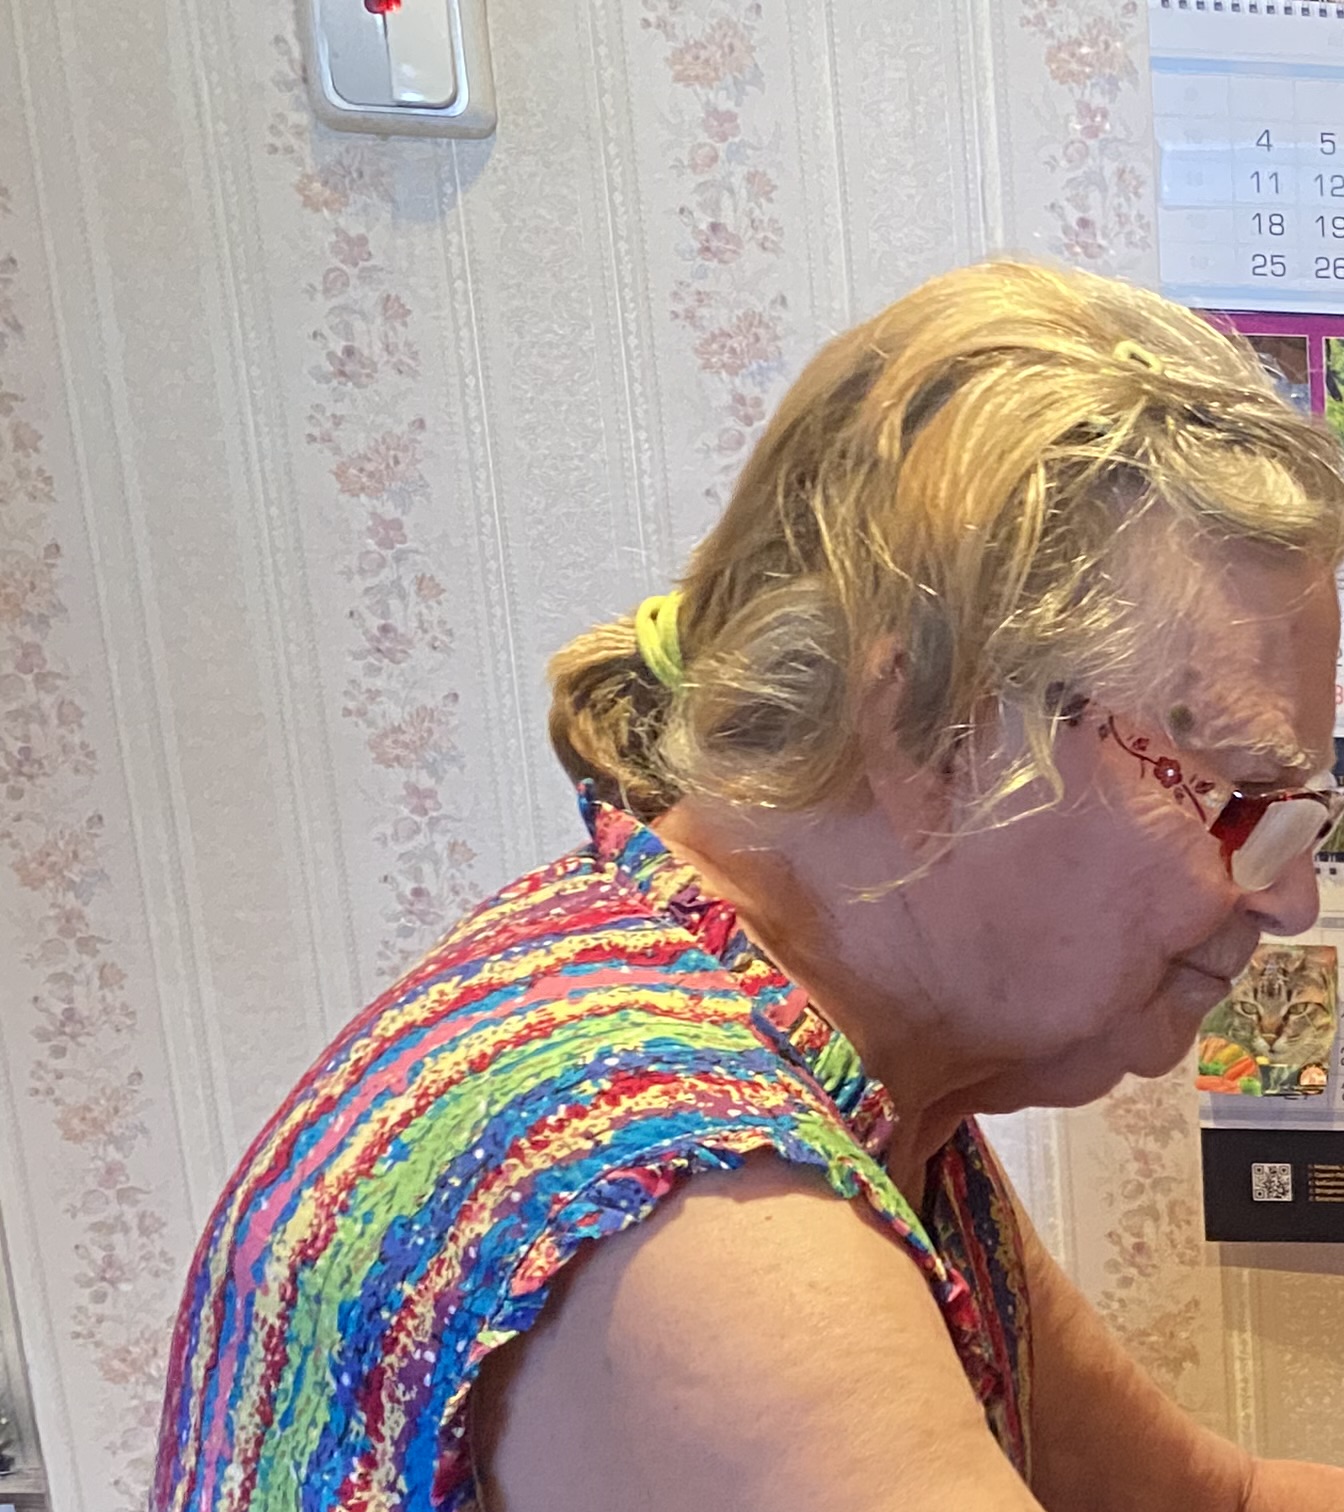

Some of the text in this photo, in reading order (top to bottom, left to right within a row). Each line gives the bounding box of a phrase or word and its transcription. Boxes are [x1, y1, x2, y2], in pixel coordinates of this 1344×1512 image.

[1256, 130, 1273, 152] 4
[1320, 133, 1336, 155] 5
[1250, 171, 1281, 195] 11
[1252, 214, 1285, 237] 18
[1251, 254, 1286, 277] 25
